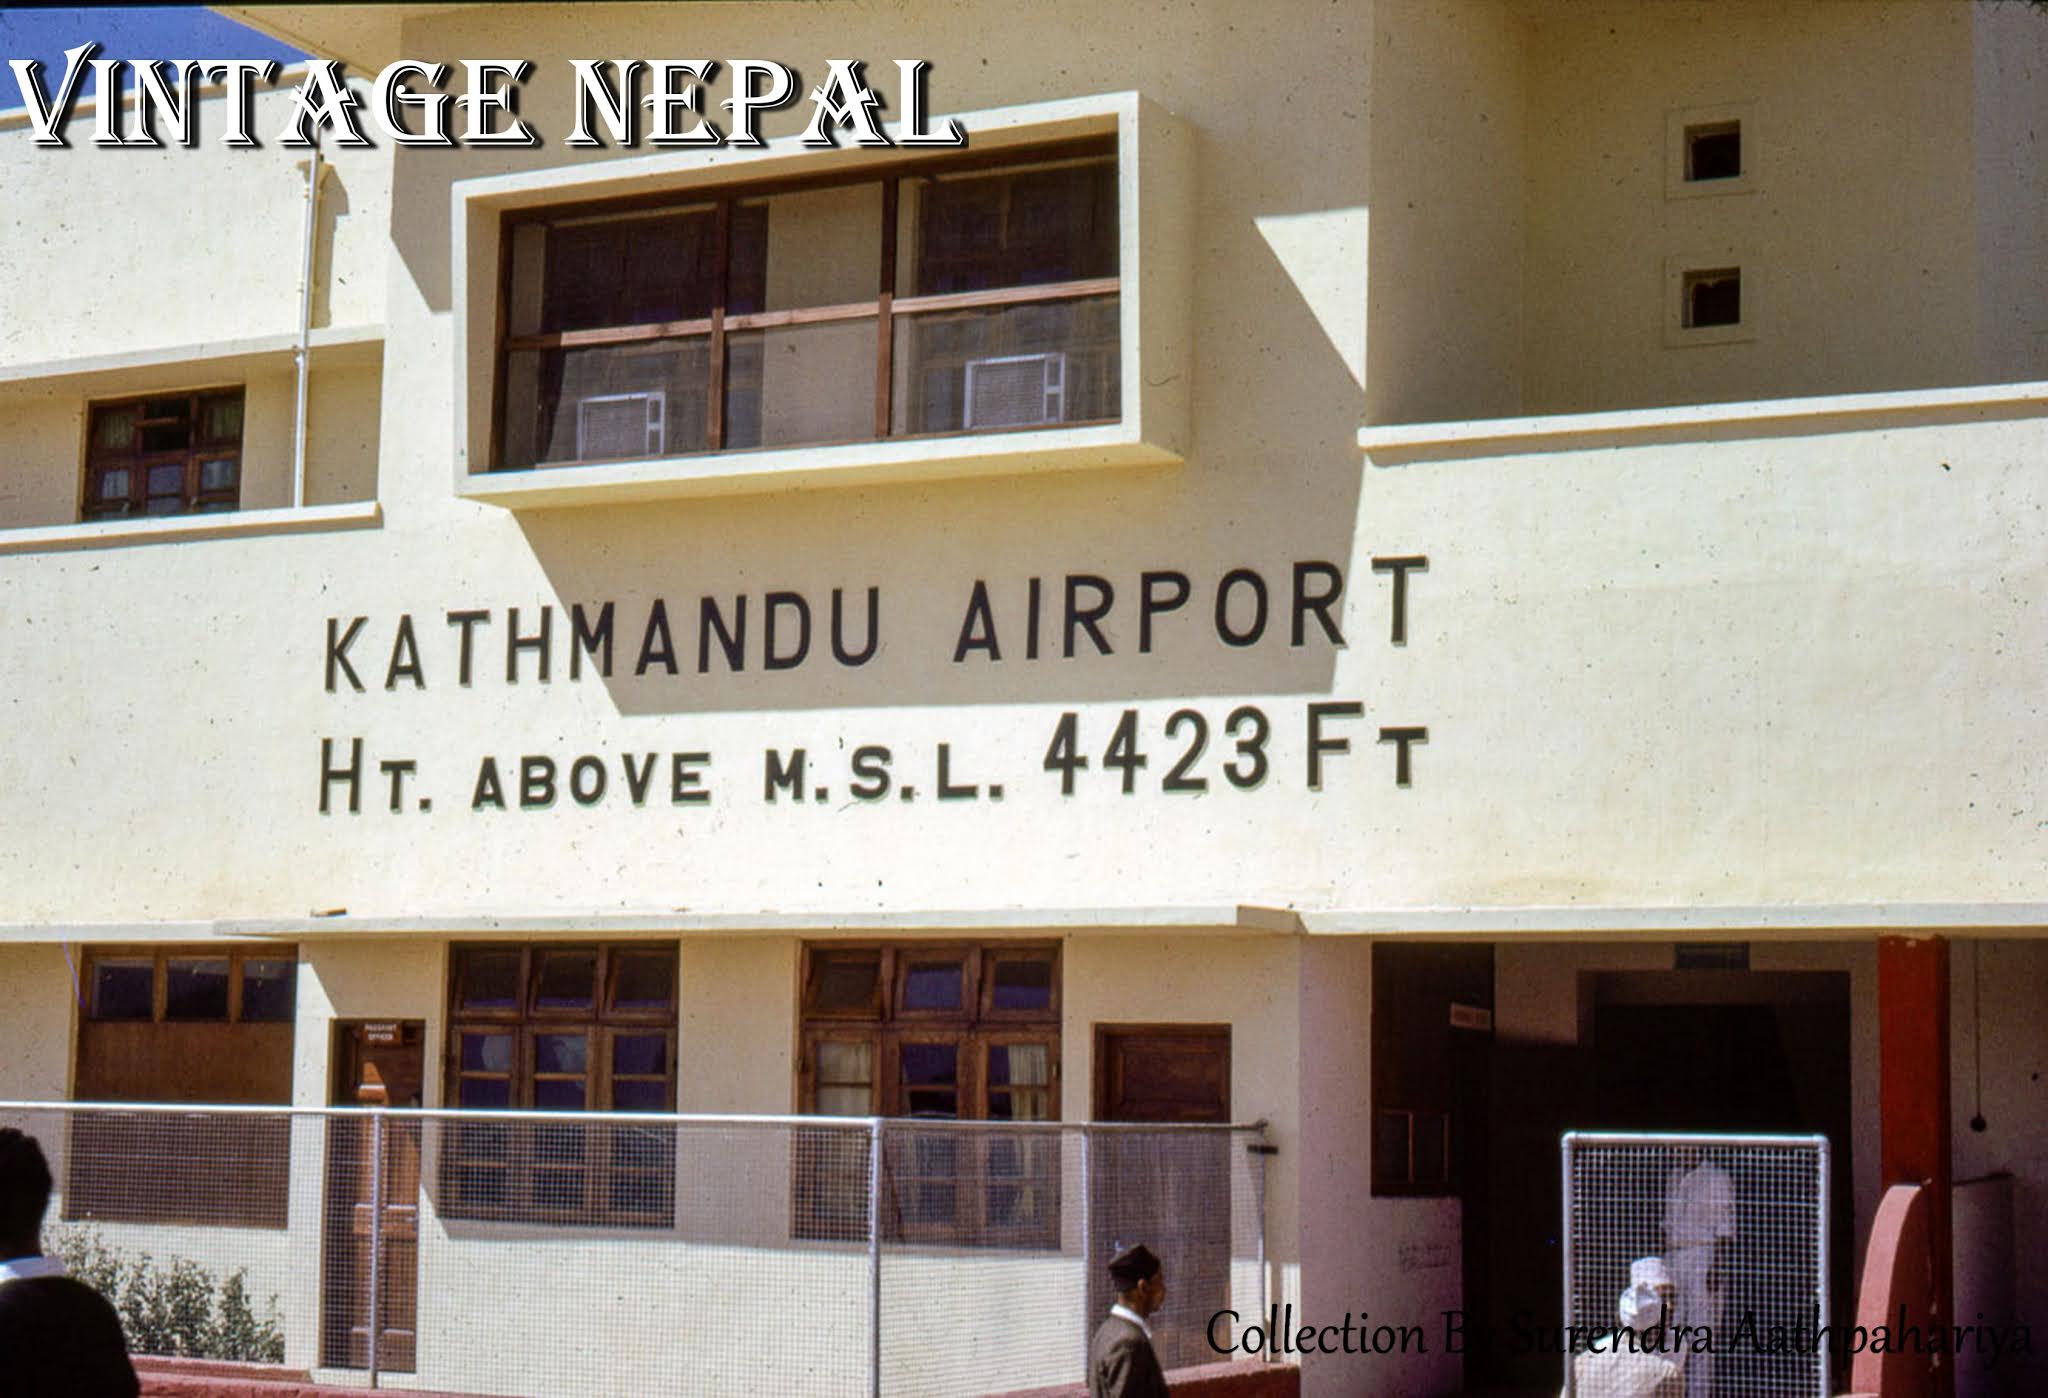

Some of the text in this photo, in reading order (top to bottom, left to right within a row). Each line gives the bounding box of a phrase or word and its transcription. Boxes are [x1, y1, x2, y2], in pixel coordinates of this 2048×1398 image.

[324, 555, 1429, 693] KATHMANDU AIRPORT
[471, 752, 712, 812] ABOVE
[764, 743, 1005, 804] M.S.L.
[1043, 705, 1271, 796] 4423
